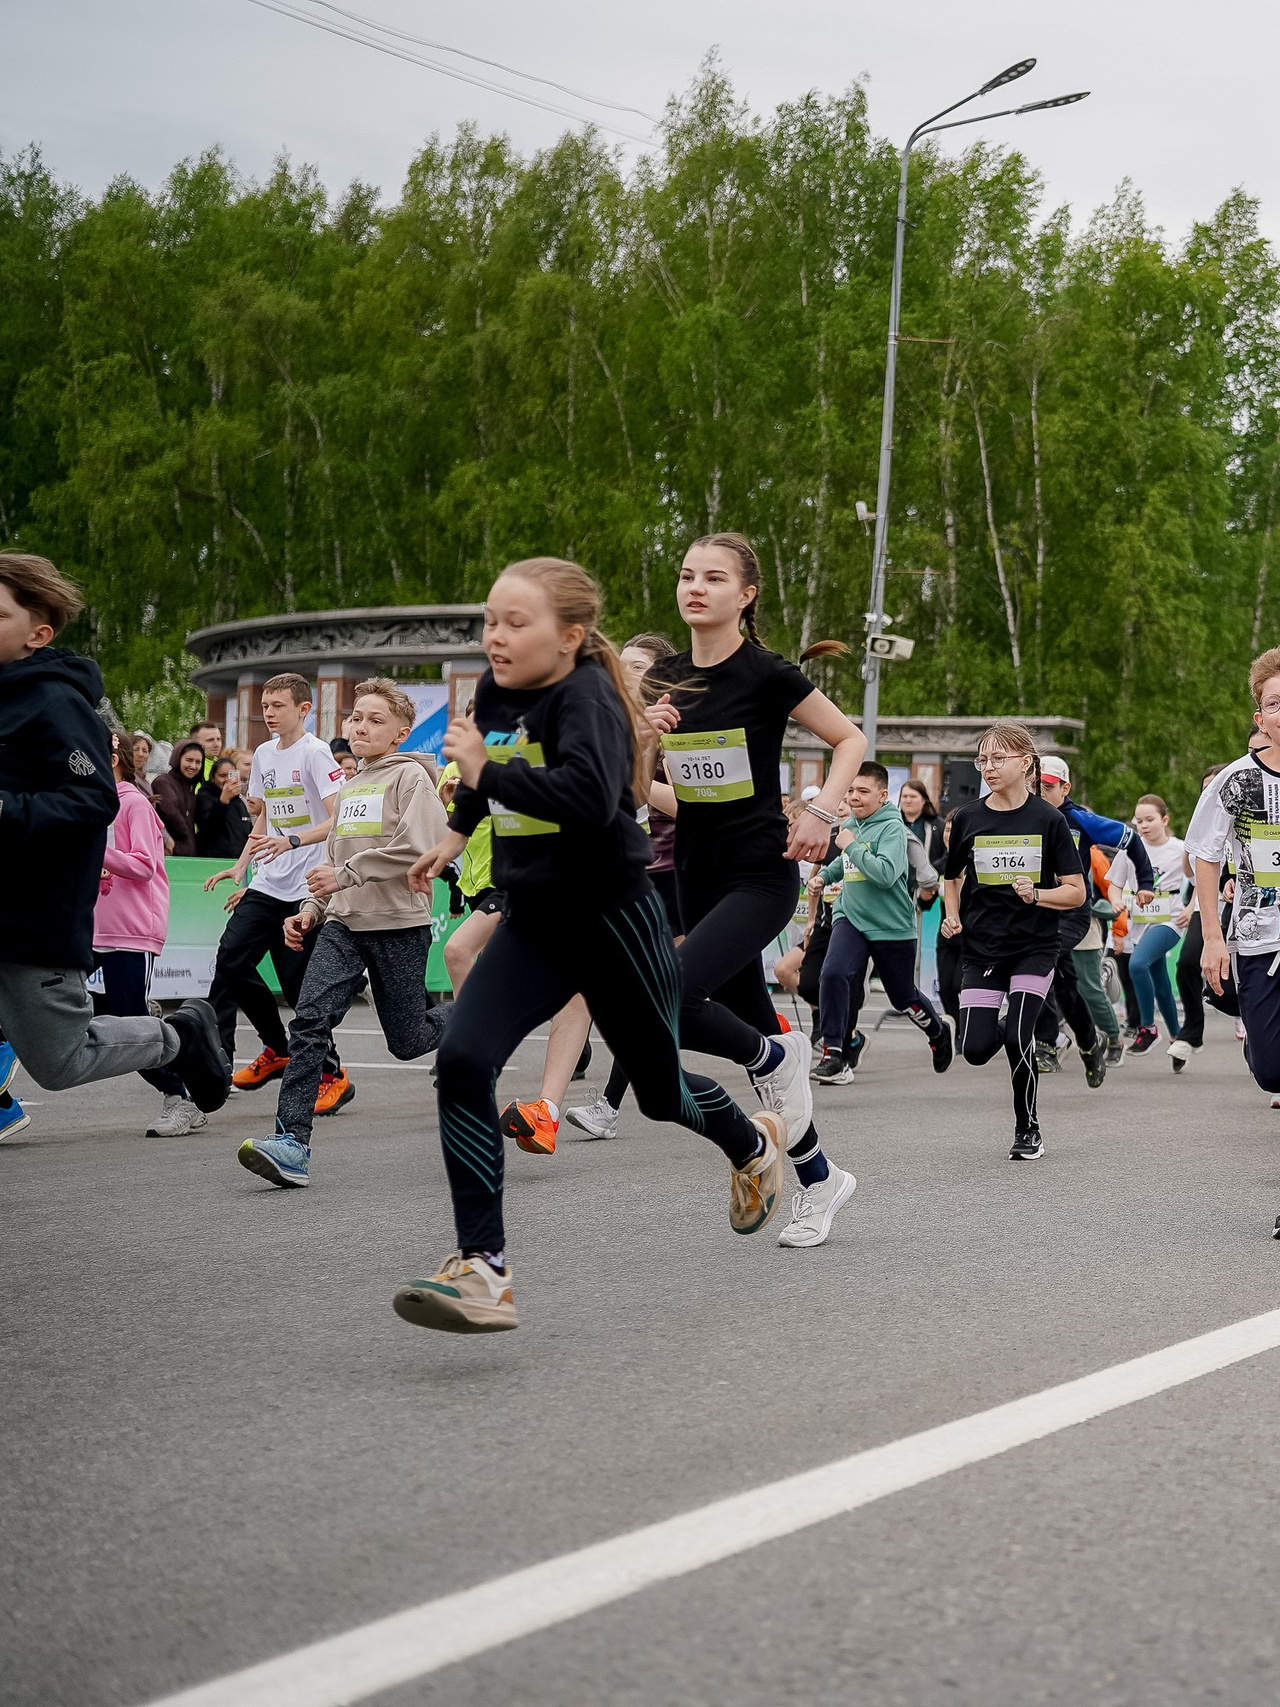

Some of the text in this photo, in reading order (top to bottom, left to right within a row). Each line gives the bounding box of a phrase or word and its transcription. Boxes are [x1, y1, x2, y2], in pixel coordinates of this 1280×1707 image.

[681, 762, 725, 780] 3180
[694, 788, 717, 797] 700м
[272, 804, 295, 815] 3118
[343, 804, 367, 818] 3162
[992, 856, 1025, 868] 3164
